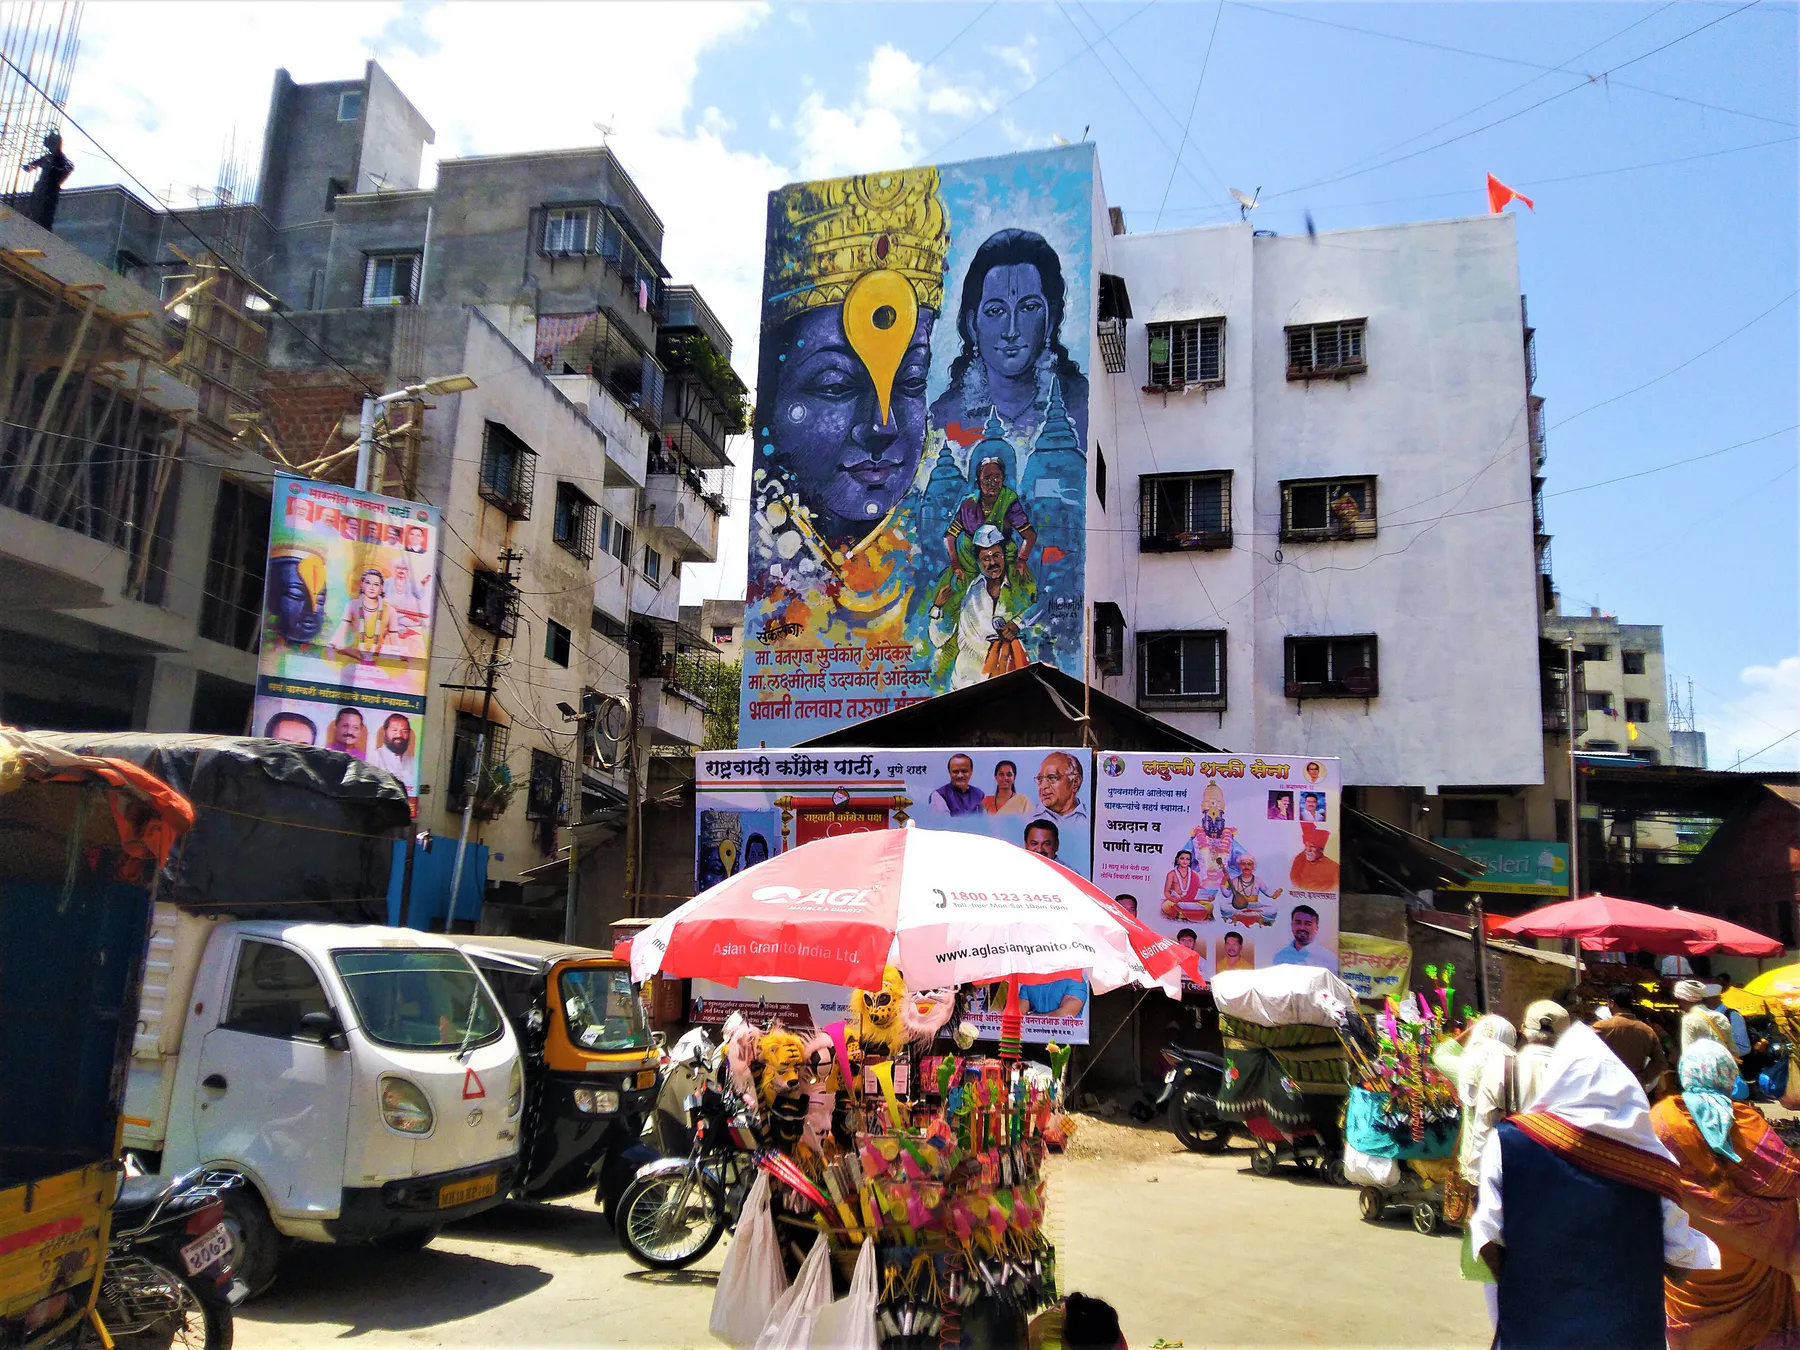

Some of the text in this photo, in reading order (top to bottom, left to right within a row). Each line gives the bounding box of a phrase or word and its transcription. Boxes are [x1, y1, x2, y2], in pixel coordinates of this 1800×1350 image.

[775, 649, 815, 667] वनराज
[866, 640, 913, 663] आंदेकर
[829, 666, 880, 690] उदयकांत
[882, 665, 932, 689] आंदेकर
[749, 693, 792, 720] भवानी
[795, 698, 843, 719] तलवार
[705, 755, 771, 779] राष्ट्रवादी
[775, 753, 829, 777] काँग्रेस
[887, 763, 904, 778] पुणे
[906, 765, 928, 775] शहर
[1142, 758, 1195, 781] लहुजी
[1250, 759, 1291, 780] सेना
[1146, 787, 1173, 797] आलेल्या
[1175, 788, 1187, 798] सर्व
[804, 811, 835, 824] राष्ट्रवादी
[867, 813, 882, 822] पक्ष
[1106, 819, 1162, 834] अन्नदान व
[1103, 839, 1163, 854] पाणी वाटप
[796, 888, 873, 906] AGL
[950, 891, 1062, 903] 1800 123 3455
[712, 940, 860, 964] Asian Granito India Ltd.
[935, 941, 1096, 964] www.aglasiangranito.com
